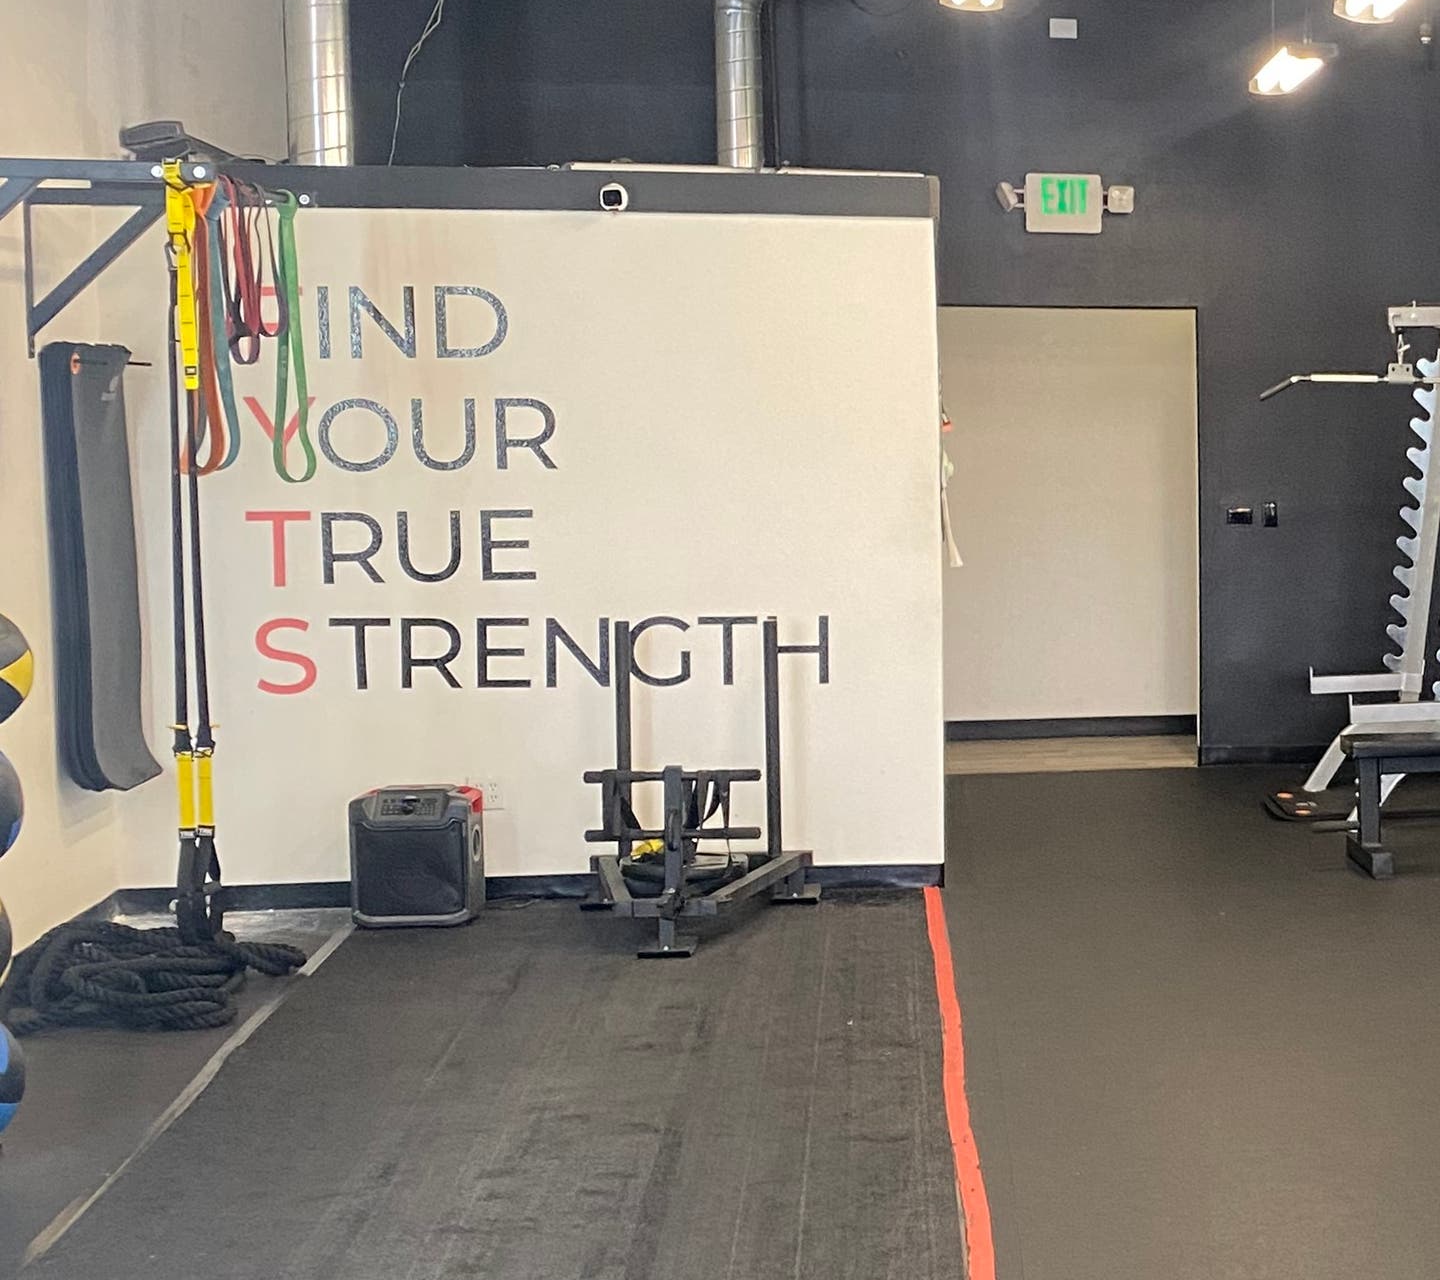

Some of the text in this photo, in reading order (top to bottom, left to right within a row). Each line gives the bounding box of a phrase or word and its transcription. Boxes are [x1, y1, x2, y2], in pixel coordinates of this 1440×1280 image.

[1041, 177, 1089, 214] EXIT
[243, 396, 559, 472] YOUR
[245, 508, 537, 588] TRUE
[254, 615, 830, 696] STRENGTH
